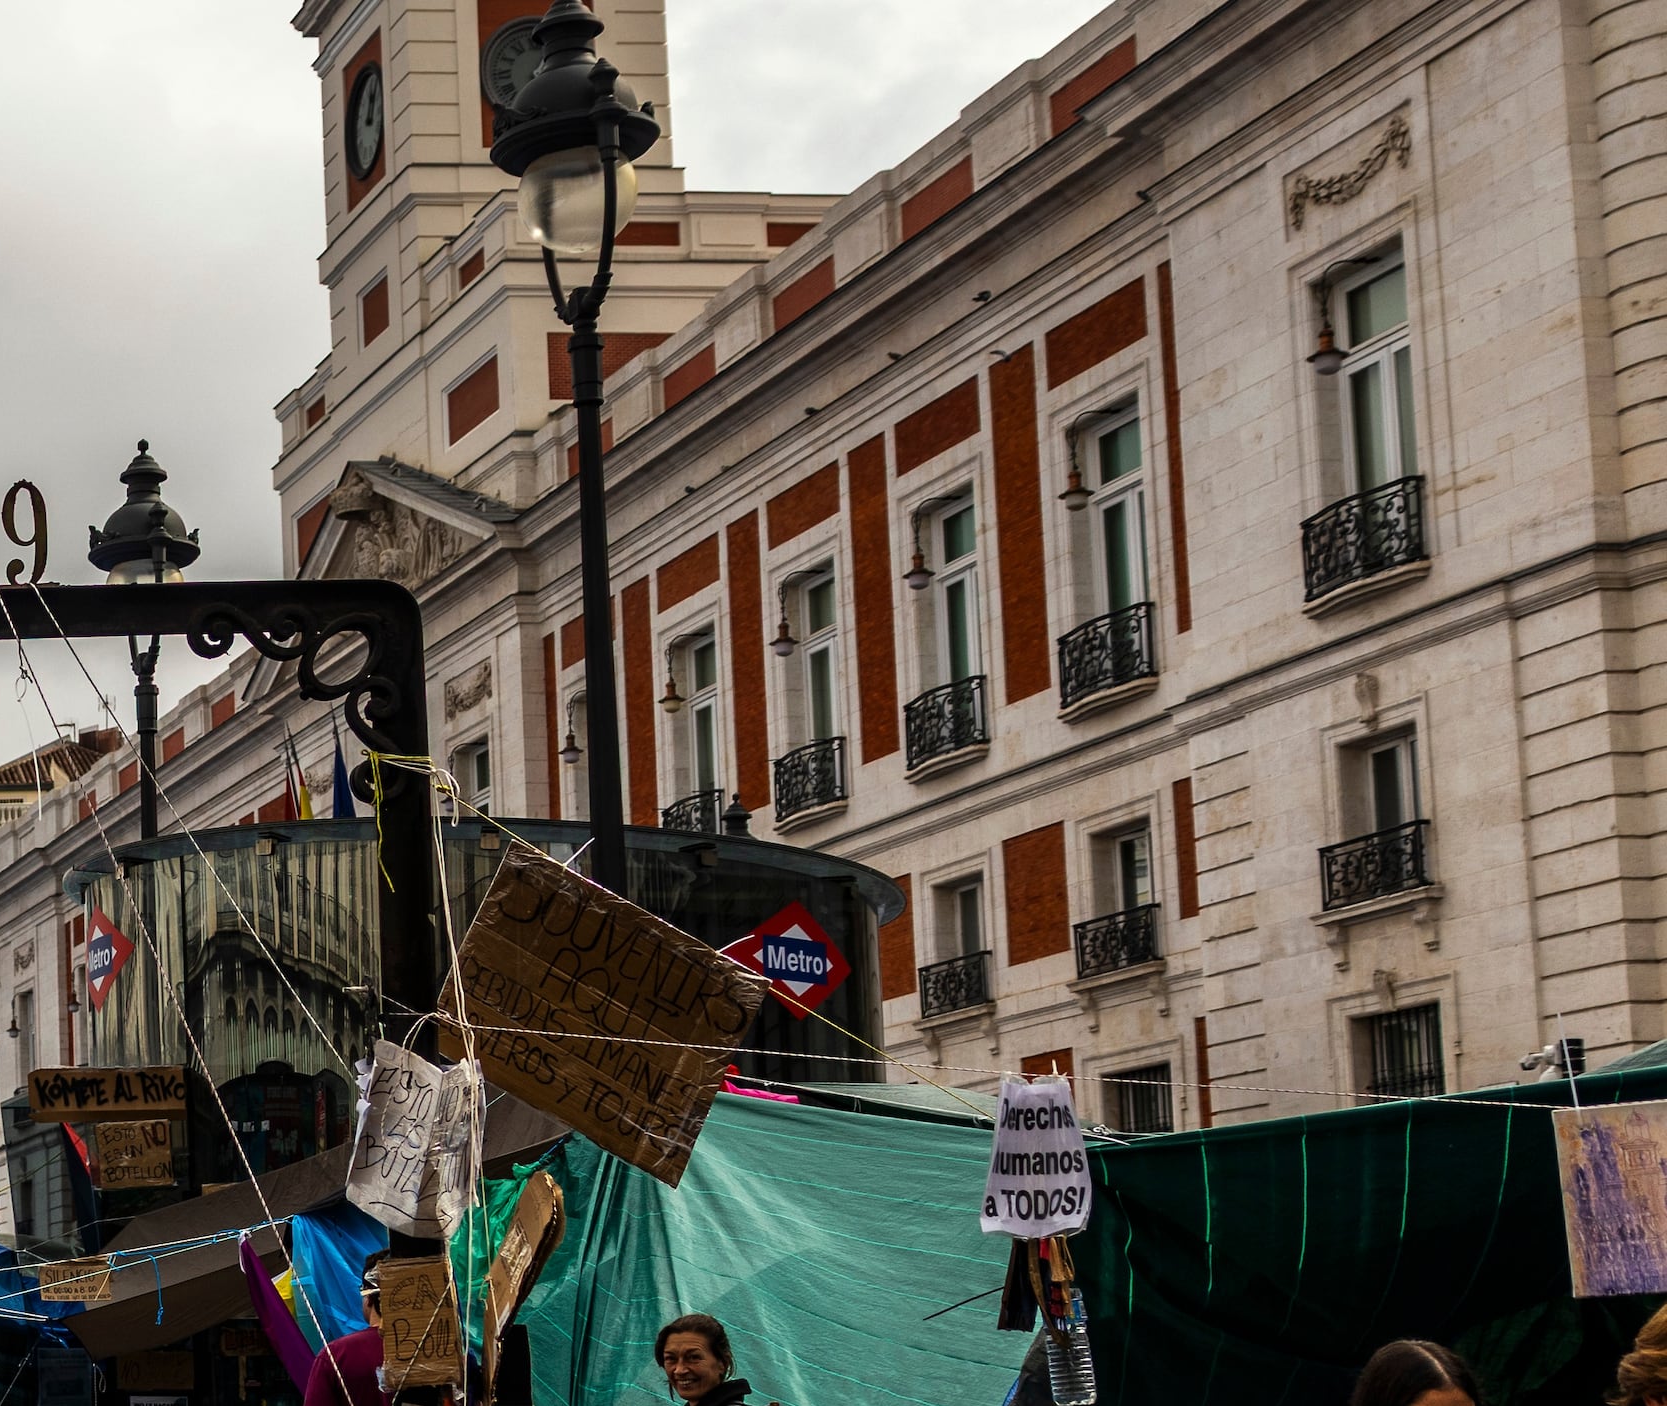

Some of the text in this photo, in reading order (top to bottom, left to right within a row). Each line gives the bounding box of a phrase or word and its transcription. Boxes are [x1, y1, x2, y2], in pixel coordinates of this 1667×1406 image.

[766, 944, 825, 977] Metro
[114, 1073, 138, 1104] AL
[102, 1122, 167, 1149] ESTO NO
[104, 1163, 173, 1183] BOTELLÓN
[985, 1186, 1086, 1220] a TODOS!
[45, 1268, 96, 1284] SILENCIO
